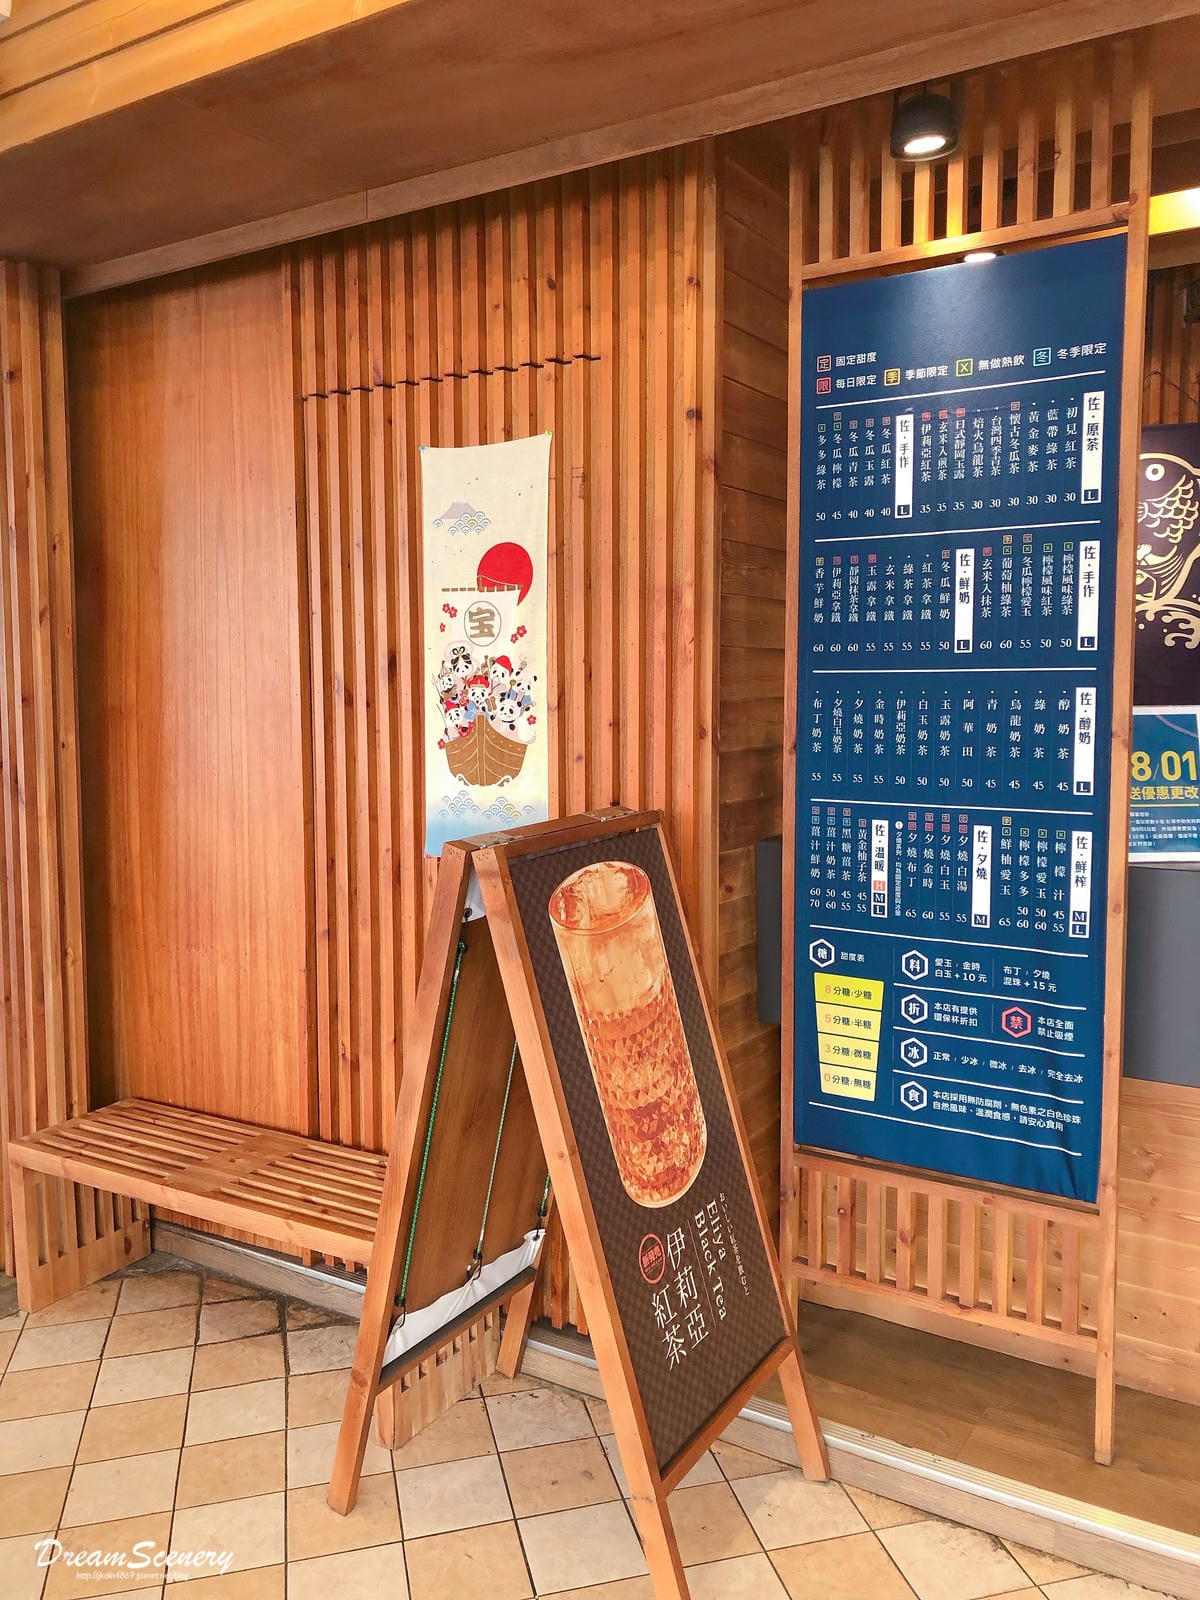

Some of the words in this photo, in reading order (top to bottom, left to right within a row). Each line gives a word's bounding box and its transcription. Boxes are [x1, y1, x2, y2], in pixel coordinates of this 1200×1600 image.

[1057, 342, 1107, 360] 冬季限定
[836, 352, 877, 367] 固定甜度
[978, 354, 1025, 370] 無做熱飲
[905, 366, 948, 380] 季節限定
[836, 375, 877, 390] 每日限定
[1028, 411, 1040, 472] 黃金麥茶
[1065, 407, 1078, 468] 初見紅茶
[848, 432, 858, 487] 冬瓜青茶
[881, 428, 892, 484] 冬瓜紅茶
[816, 435, 827, 490] 多多綠茶
[1008, 497, 1019, 506] 30
[1026, 496, 1038, 505] 30
[1045, 494, 1057, 503] 30
[1064, 492, 1076, 502] 30
[937, 503, 947, 512] 35
[953, 502, 964, 511] 35
[972, 500, 983, 510] 30
[990, 499, 1001, 508] 30
[864, 509, 874, 518] 40
[881, 508, 890, 516] 40
[920, 505, 930, 513] 35
[816, 512, 826, 521] 50
[832, 511, 842, 520] 45
[848, 510, 858, 519] 40
[884, 564, 895, 622] 玄米拿鐵
[902, 564, 914, 621] 綠茶拿鐵
[921, 563, 932, 620] 紅茶拿鐵
[939, 562, 951, 620] 冬瓜鮮奶
[814, 568, 824, 624] 香芋鮮奶
[866, 643, 876, 651] 55
[884, 643, 894, 651] 55
[902, 642, 912, 651] 55
[920, 642, 931, 650] 55
[939, 641, 950, 650] 50
[980, 640, 992, 649] 60
[1000, 640, 1012, 648] 60
[1020, 640, 1031, 648] 55
[1040, 639, 1052, 648] 50
[1060, 638, 1072, 647] 50
[813, 644, 824, 652] 60
[830, 644, 841, 652] 60
[848, 643, 858, 652] 60
[812, 698, 822, 752] 布丁奶茶
[874, 698, 884, 754] 金時奶茶
[917, 698, 928, 756] 白玉奶茶
[963, 698, 974, 757] 阿華田
[986, 698, 998, 758] 青奶茶
[1009, 698, 1022, 758] 烏龍奶茶
[1033, 698, 1046, 758] 綠奶茶
[1058, 698, 1070, 759] 醇奶茶
[812, 772, 822, 781] 55
[832, 773, 842, 782] 55
[852, 774, 863, 783] 55
[873, 775, 884, 784] 55
[895, 776, 906, 785] 50
[917, 776, 928, 786] 50
[939, 778, 950, 786] 50
[962, 778, 973, 787] 50
[985, 779, 996, 788] 45
[1009, 780, 1020, 789] 45
[1032, 781, 1044, 790] 45
[1057, 782, 1068, 791] 45
[1000, 839, 1012, 895] 鮮柚愛玉
[1054, 843, 1066, 901] 檸檬汁
[810, 888, 821, 896] 60
[826, 889, 835, 897] 50
[842, 891, 851, 899] 45
[857, 892, 867, 900] 45
[841, 903, 851, 911] 55
[857, 904, 867, 912] 55
[1017, 906, 1028, 916] 50
[906, 909, 917, 917] 65
[922, 911, 933, 919] 60
[939, 912, 950, 921] 55
[956, 913, 967, 922] 55
[1036, 908, 1046, 918] 50
[1053, 910, 1064, 920] 45
[999, 918, 1011, 926] 65
[1017, 920, 1029, 928] 60
[1035, 922, 1047, 931] 60
[1053, 923, 1064, 932] 55
[840, 952, 865, 962] 甜度表
[934, 1002, 978, 1016] 本店有提供
[934, 1013, 978, 1027] 環保杯折扣
[1038, 1016, 1074, 1030] 本店全面
[706, 1199, 728, 1261] Eliya
[694, 1210, 717, 1277] Black
[712, 1276, 728, 1321] Tea
[666, 1228, 709, 1349] 伊莉亞
[652, 1284, 688, 1371] 紅茶
